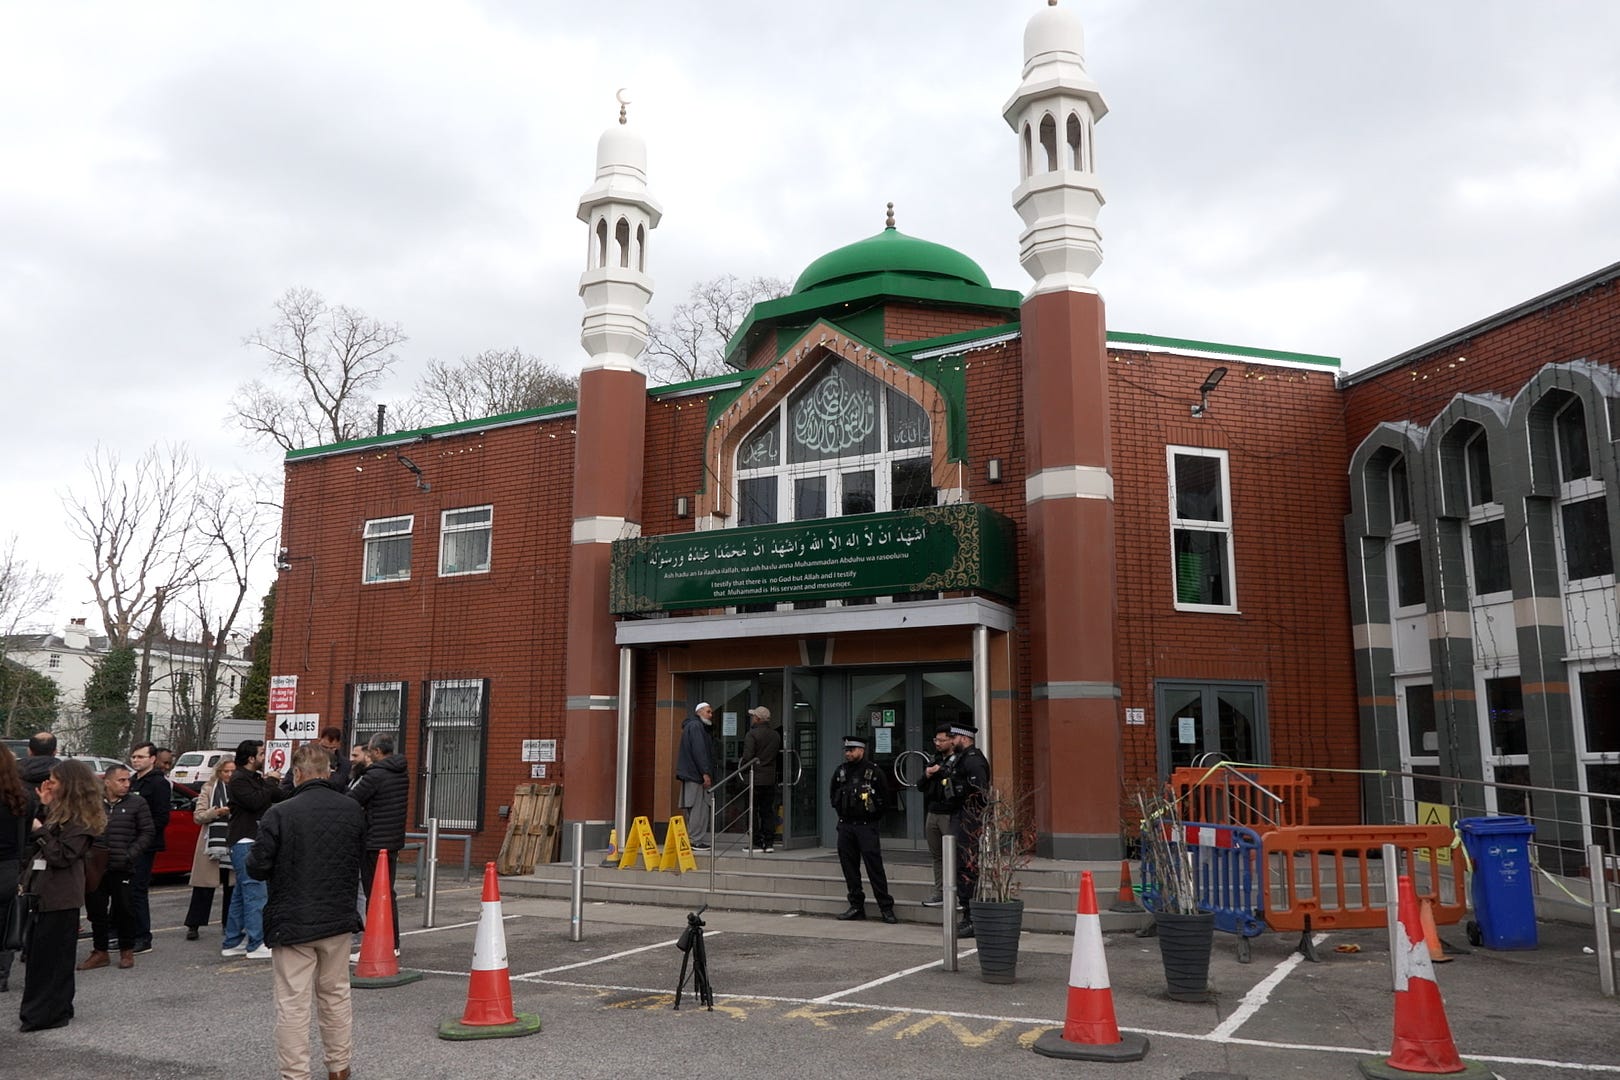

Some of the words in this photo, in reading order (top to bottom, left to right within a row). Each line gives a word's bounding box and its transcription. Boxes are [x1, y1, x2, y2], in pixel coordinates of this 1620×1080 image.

[714, 580, 731, 589] testify
[746, 577, 761, 585] there
[779, 575, 791, 583] God
[804, 572, 820, 581] Allah
[821, 571, 833, 580] and
[837, 569, 857, 579] testify
[727, 587, 762, 596] Muhammad
[781, 583, 803, 592] servant
[804, 582, 816, 590] and
[289, 721, 316, 731] LADIES
